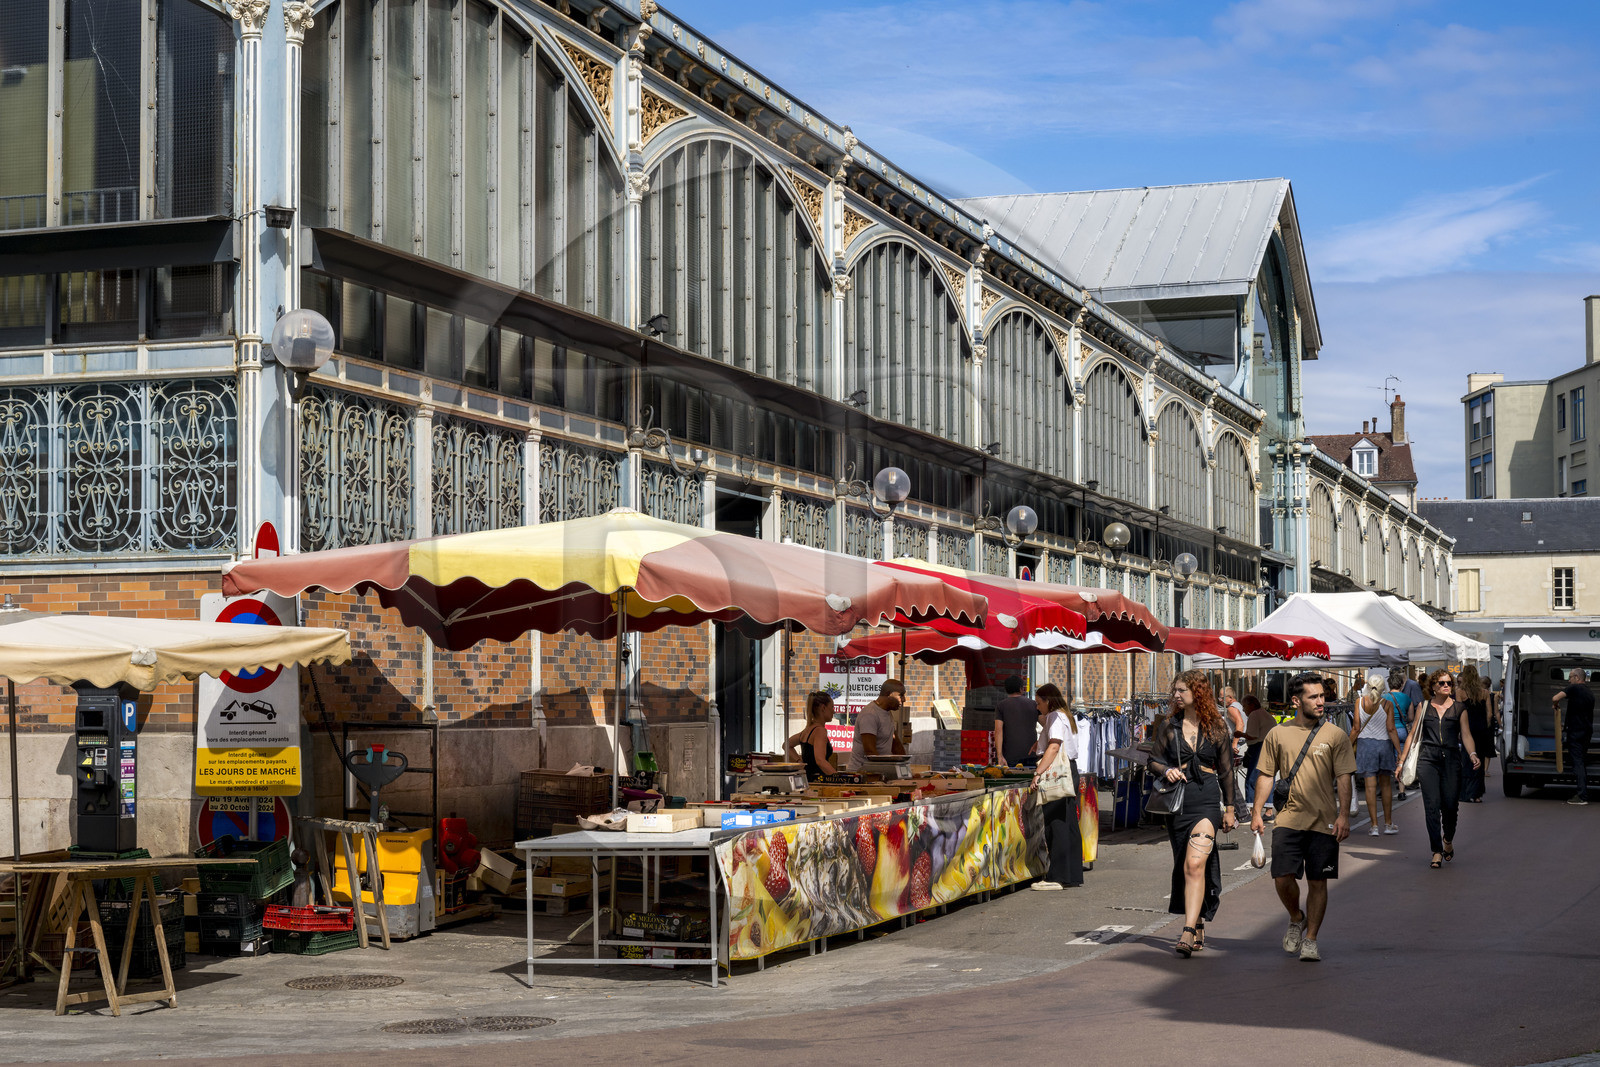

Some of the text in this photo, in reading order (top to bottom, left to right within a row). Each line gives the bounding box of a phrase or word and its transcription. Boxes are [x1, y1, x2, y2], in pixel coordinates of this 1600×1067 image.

[846, 656, 880, 665] ergers
[126, 703, 134, 726] P
[827, 730, 854, 738] RODUCT
[830, 739, 845, 748] ÔTES
[260, 766, 296, 775] MARCHÉ
